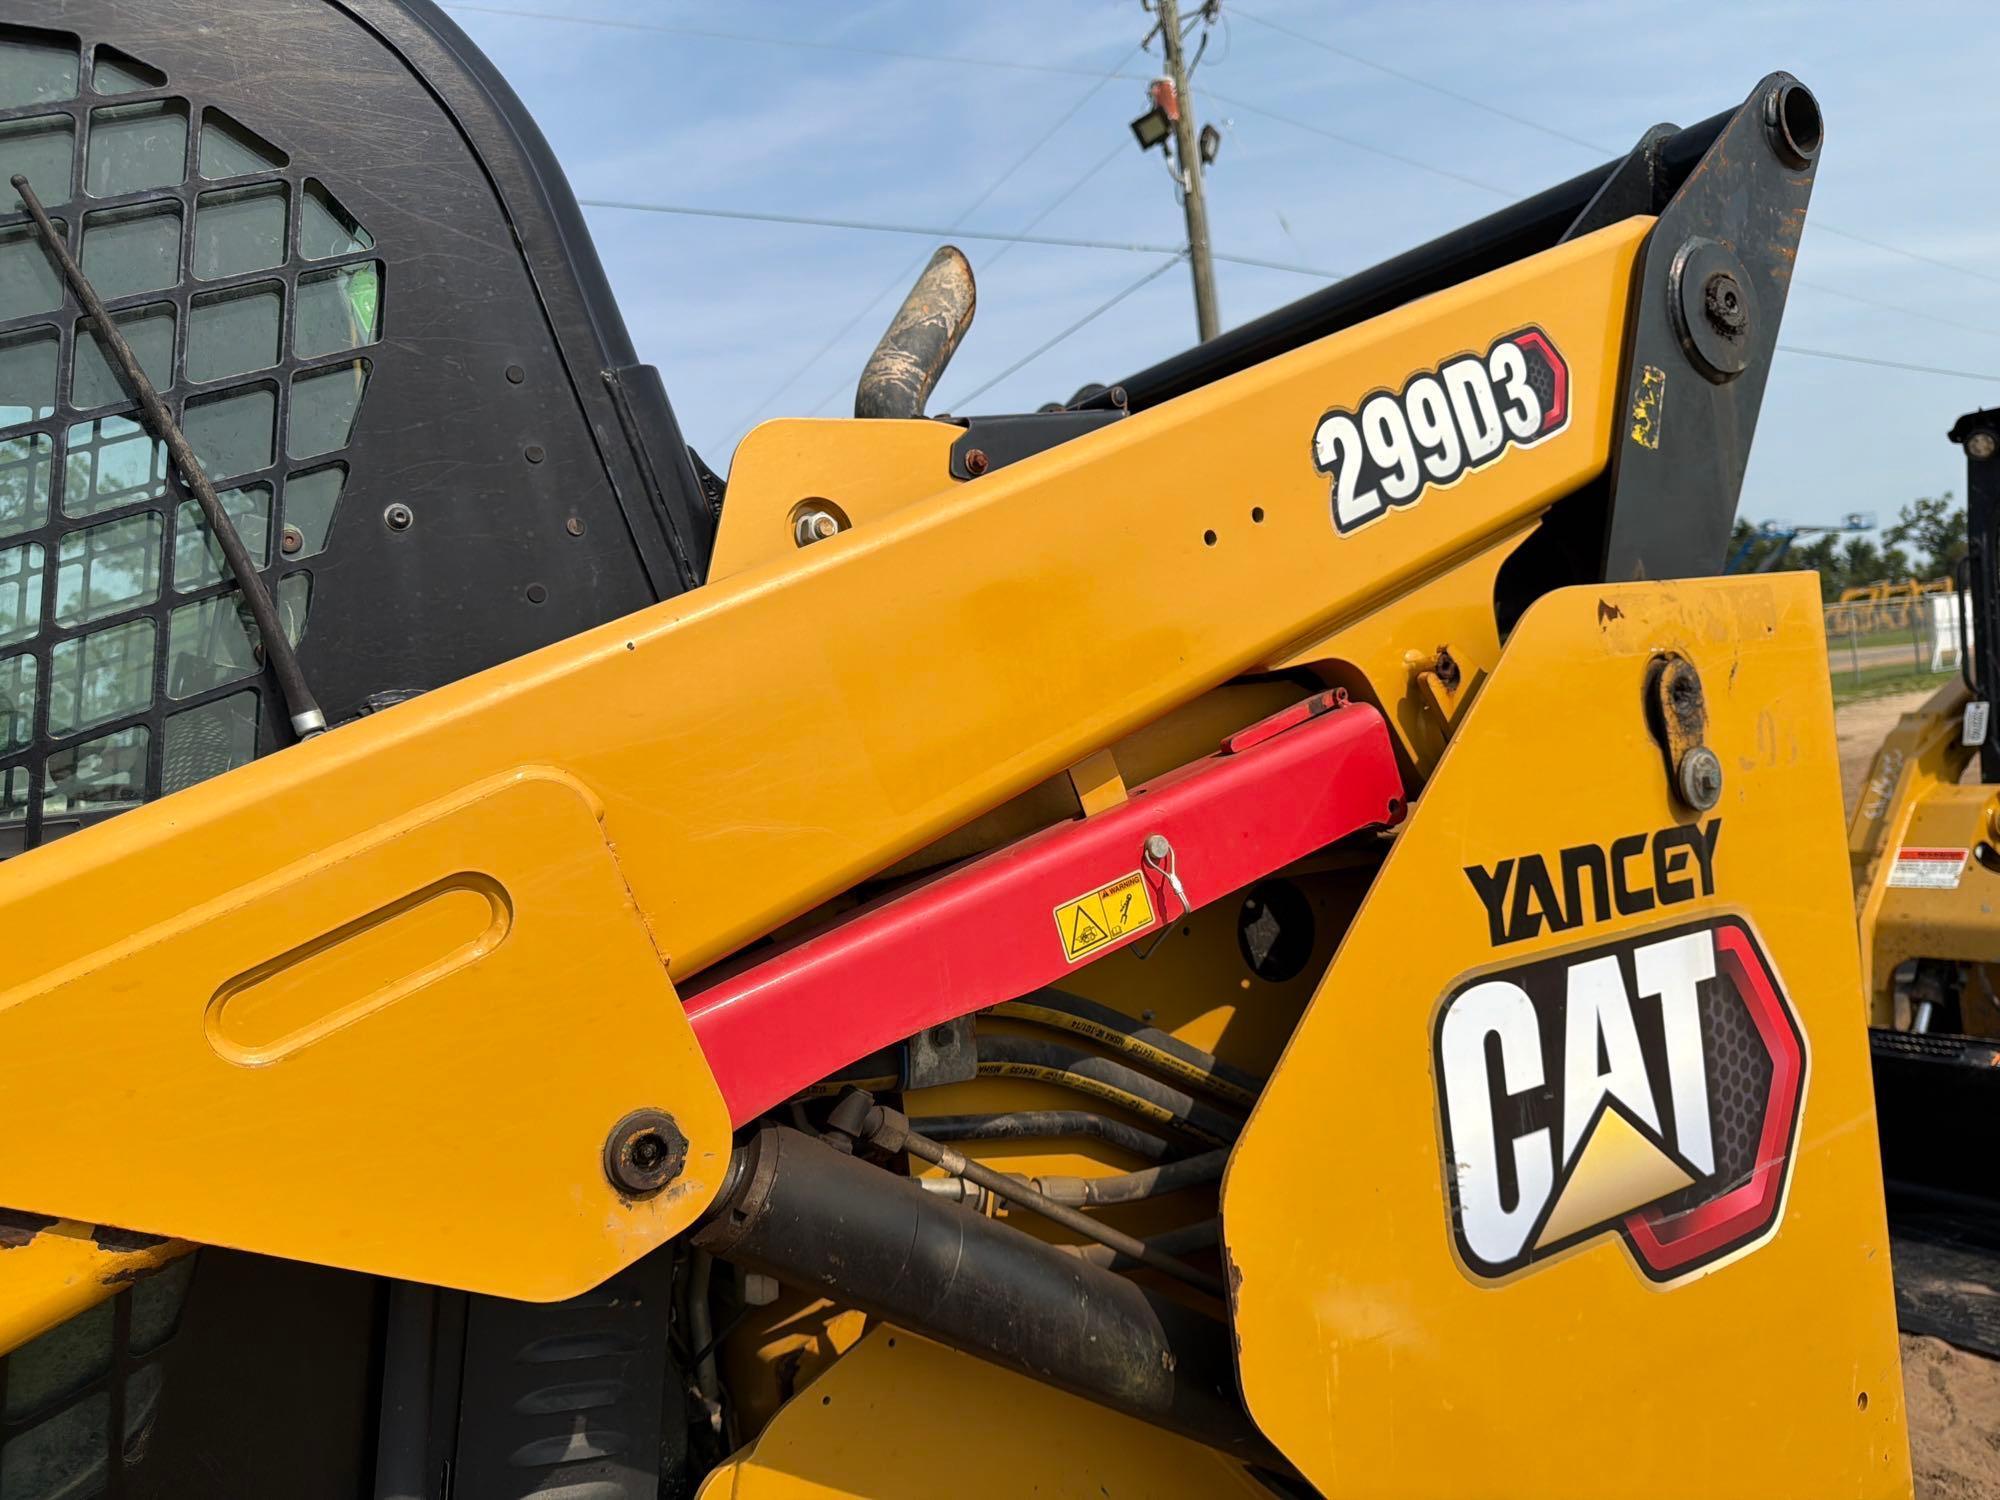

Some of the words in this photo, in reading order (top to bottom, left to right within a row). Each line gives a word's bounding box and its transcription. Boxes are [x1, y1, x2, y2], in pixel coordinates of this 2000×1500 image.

[1317, 342, 1542, 525] 299D3
[1109, 876, 1139, 894] WARNING
[1463, 817, 1722, 948] YANCEY
[1440, 928, 1717, 1265] CAT
